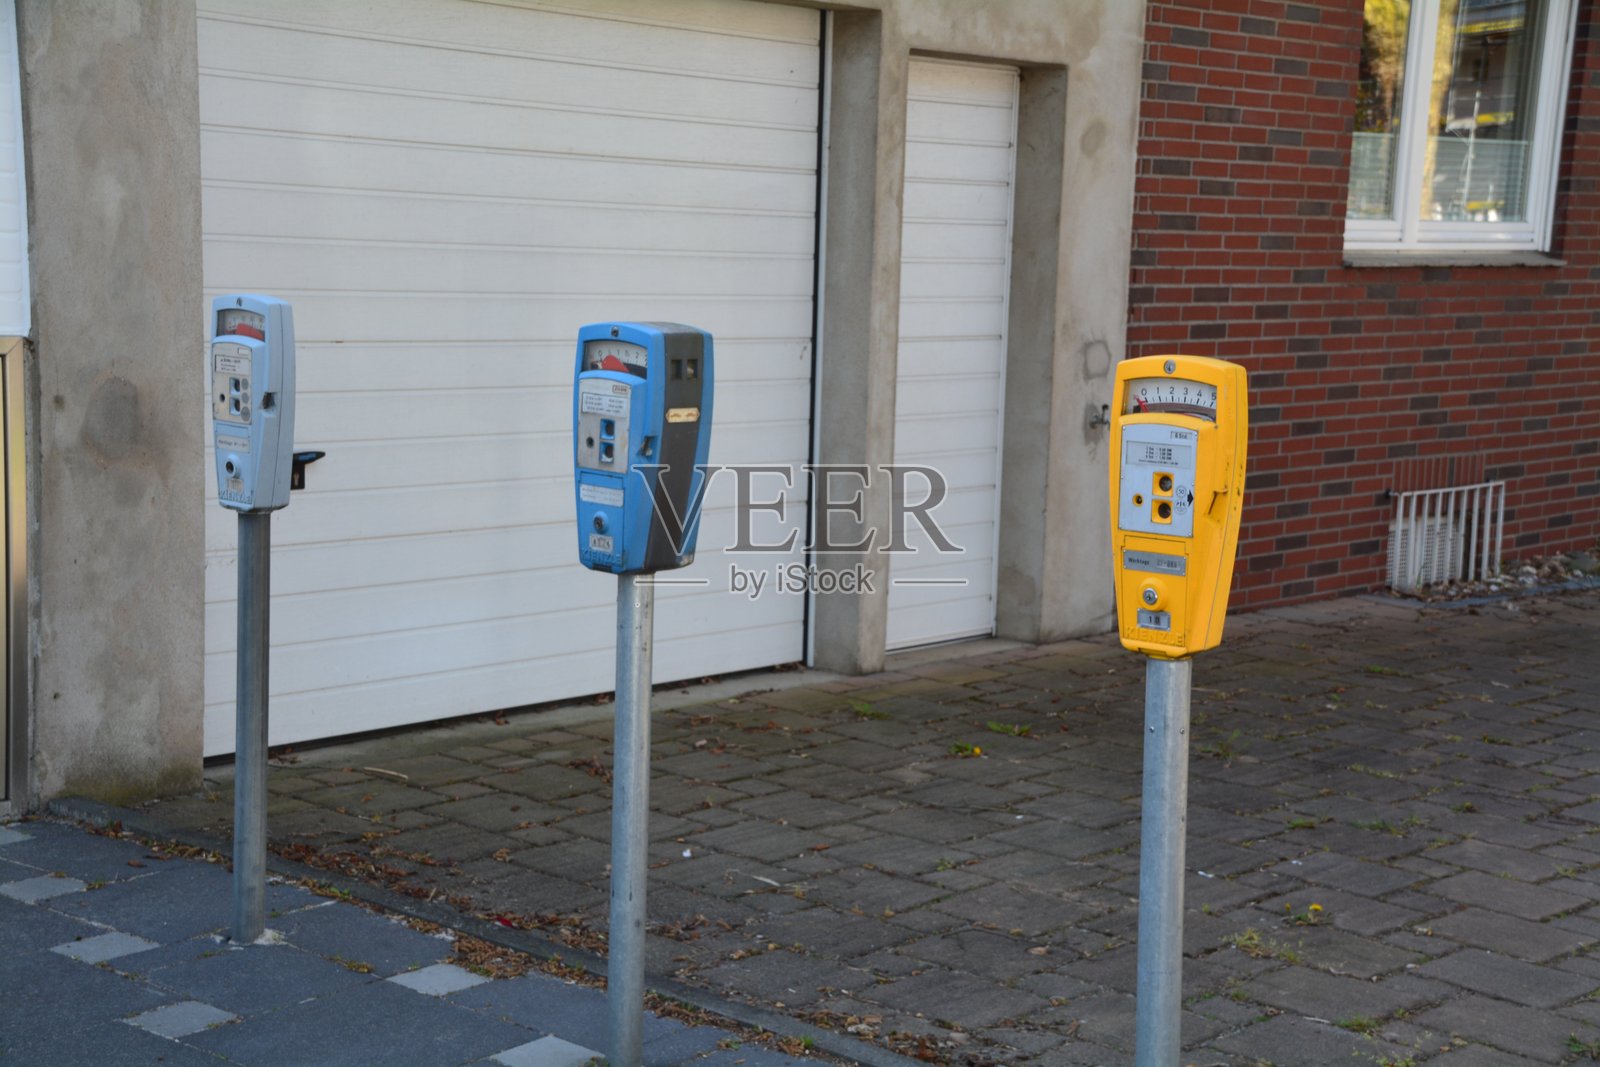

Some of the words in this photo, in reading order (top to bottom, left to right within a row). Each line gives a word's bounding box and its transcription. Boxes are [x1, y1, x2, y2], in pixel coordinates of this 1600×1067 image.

[1141, 388, 1147, 396] 0
[1169, 386, 1175, 395] 2
[1183, 387, 1188, 395] 3
[1197, 389, 1202, 397] 4
[1211, 393, 1216, 401] 5
[582, 548, 623, 566] KIENZLE
[1125, 625, 1184, 648] KIENZLE
